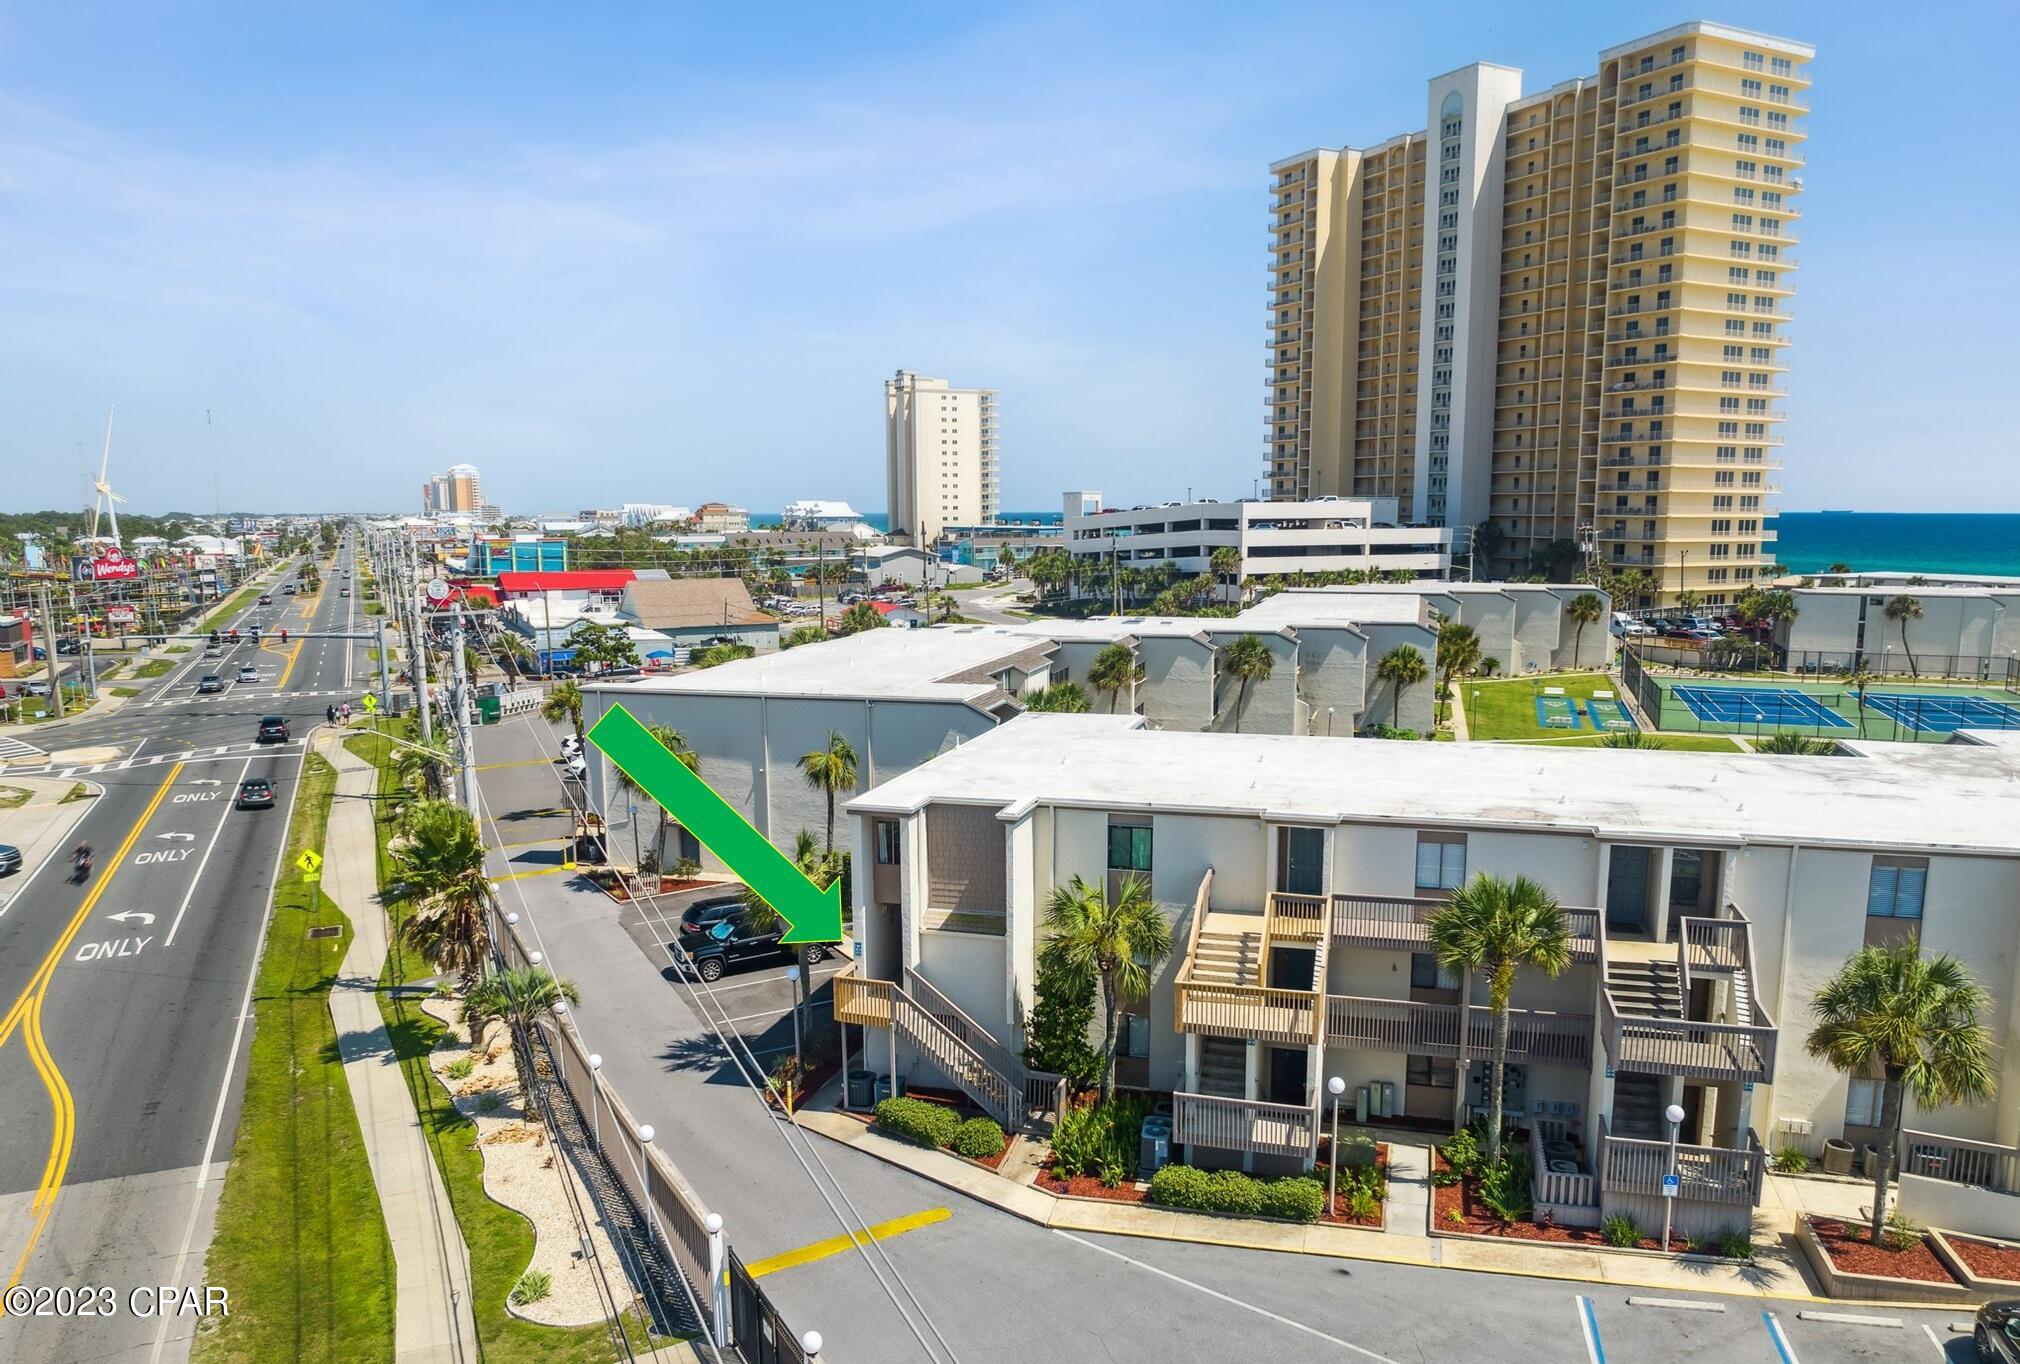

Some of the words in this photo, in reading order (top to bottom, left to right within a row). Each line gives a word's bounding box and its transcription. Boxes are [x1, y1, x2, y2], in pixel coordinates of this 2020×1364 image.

[97, 562, 135, 576] Wendy's
[172, 791, 222, 803] ONLY
[134, 848, 196, 864] ONLY
[75, 936, 154, 961] ONLY
